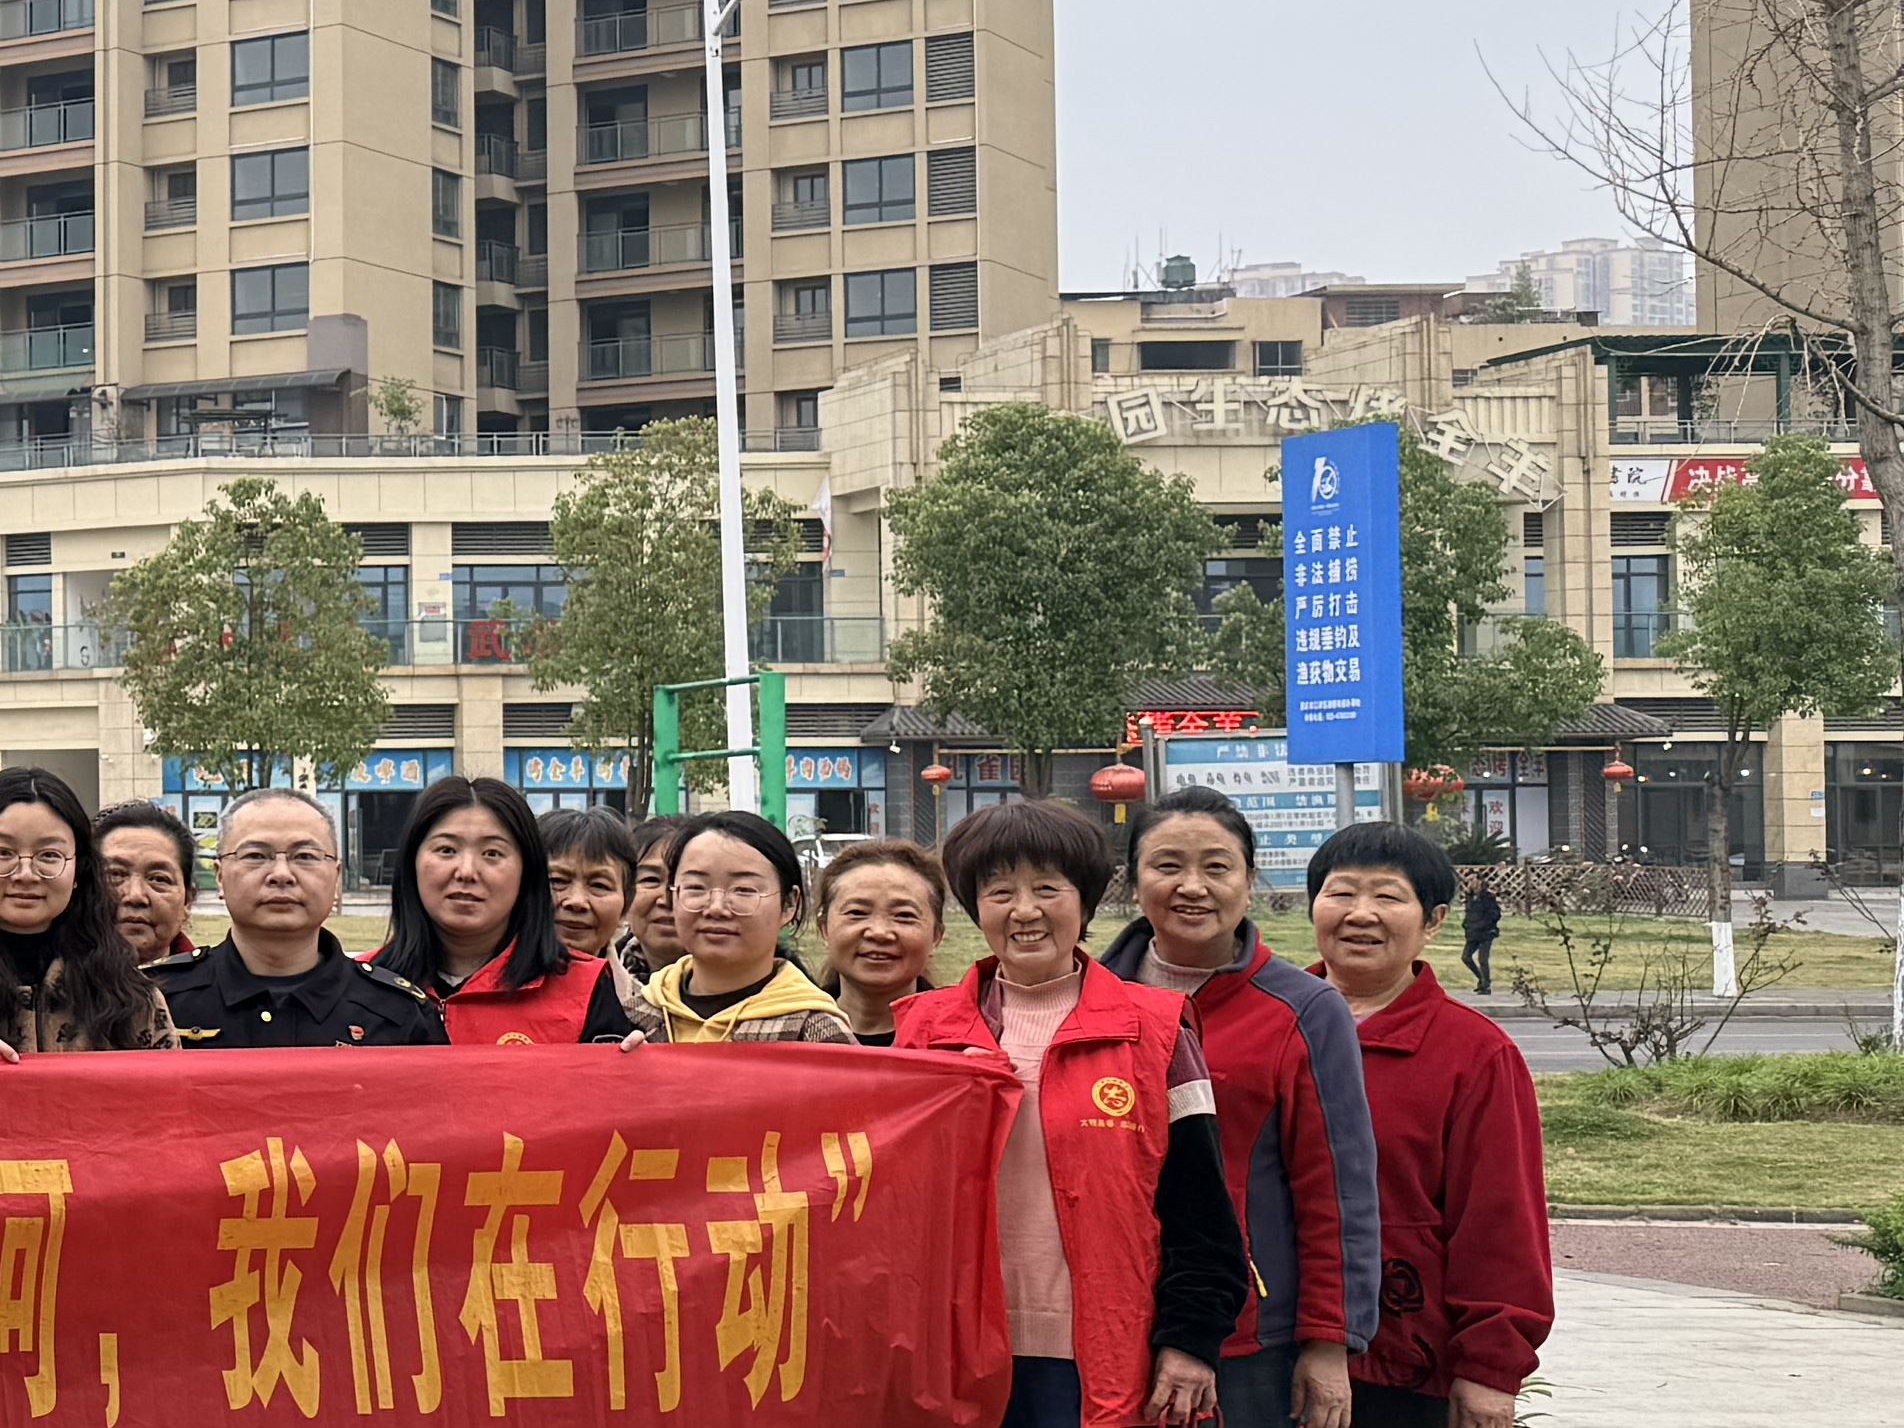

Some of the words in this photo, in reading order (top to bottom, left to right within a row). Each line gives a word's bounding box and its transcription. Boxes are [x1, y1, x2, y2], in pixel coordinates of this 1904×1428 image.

[1294, 524, 1359, 554] 全面禁止
[1295, 557, 1358, 587] 非法捕捞
[1295, 590, 1359, 620] 严厉打击
[1296, 624, 1360, 652] 违规垂钓及
[1296, 657, 1361, 685] 渔获物交易
